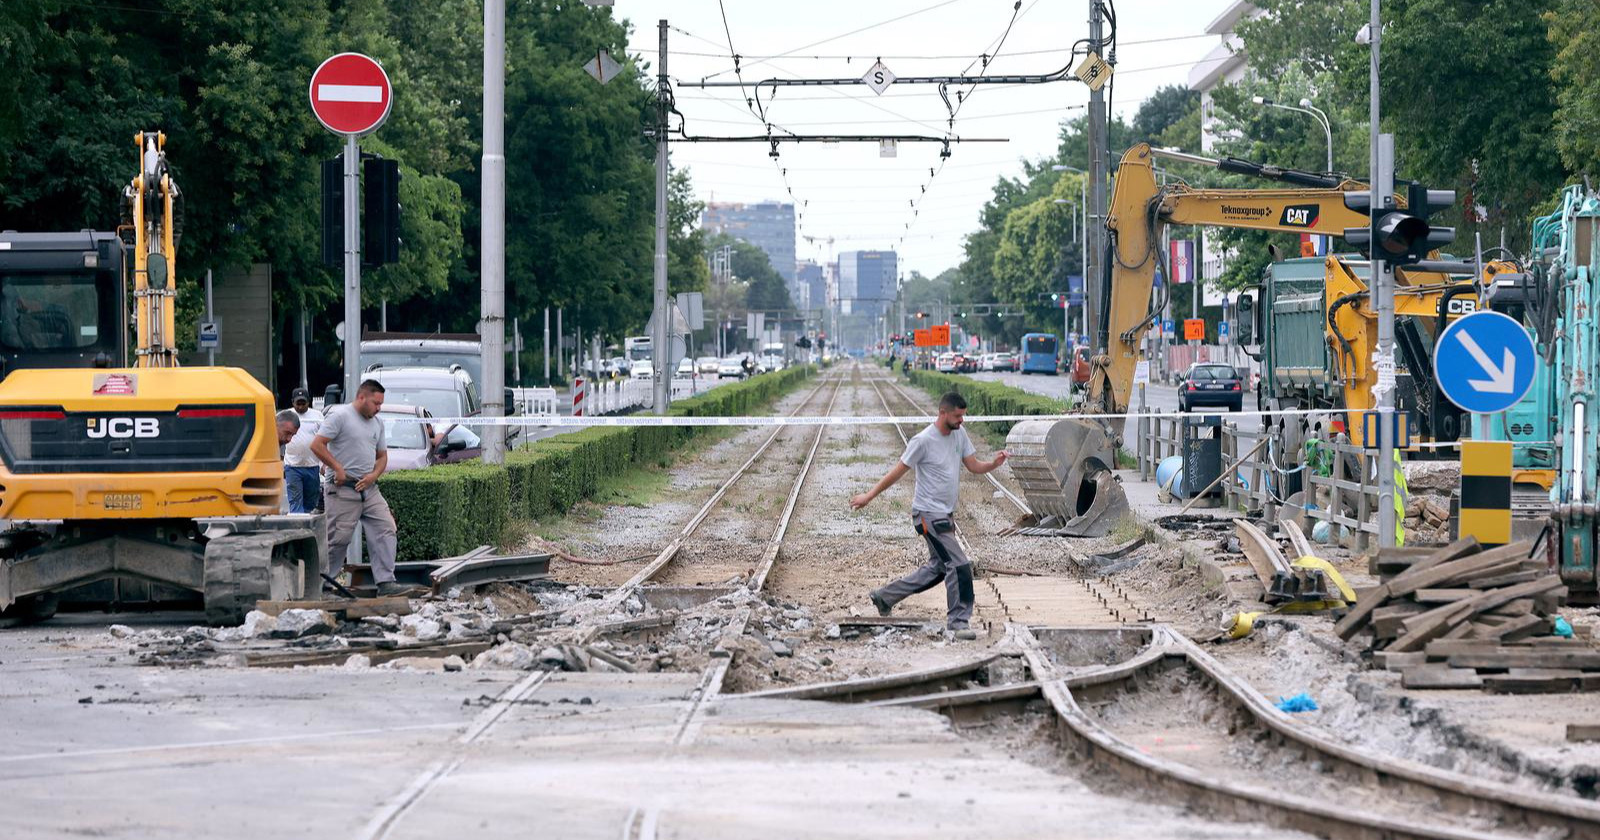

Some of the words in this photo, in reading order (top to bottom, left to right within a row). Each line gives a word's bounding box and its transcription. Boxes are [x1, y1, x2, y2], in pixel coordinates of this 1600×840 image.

[874, 71, 884, 85] S
[1221, 205, 1265, 217] Teknoxgroup
[1286, 208, 1309, 225] CAT
[1436, 299, 1476, 313] CB
[1165, 321, 1172, 331] P
[87, 417, 160, 439] JCB
